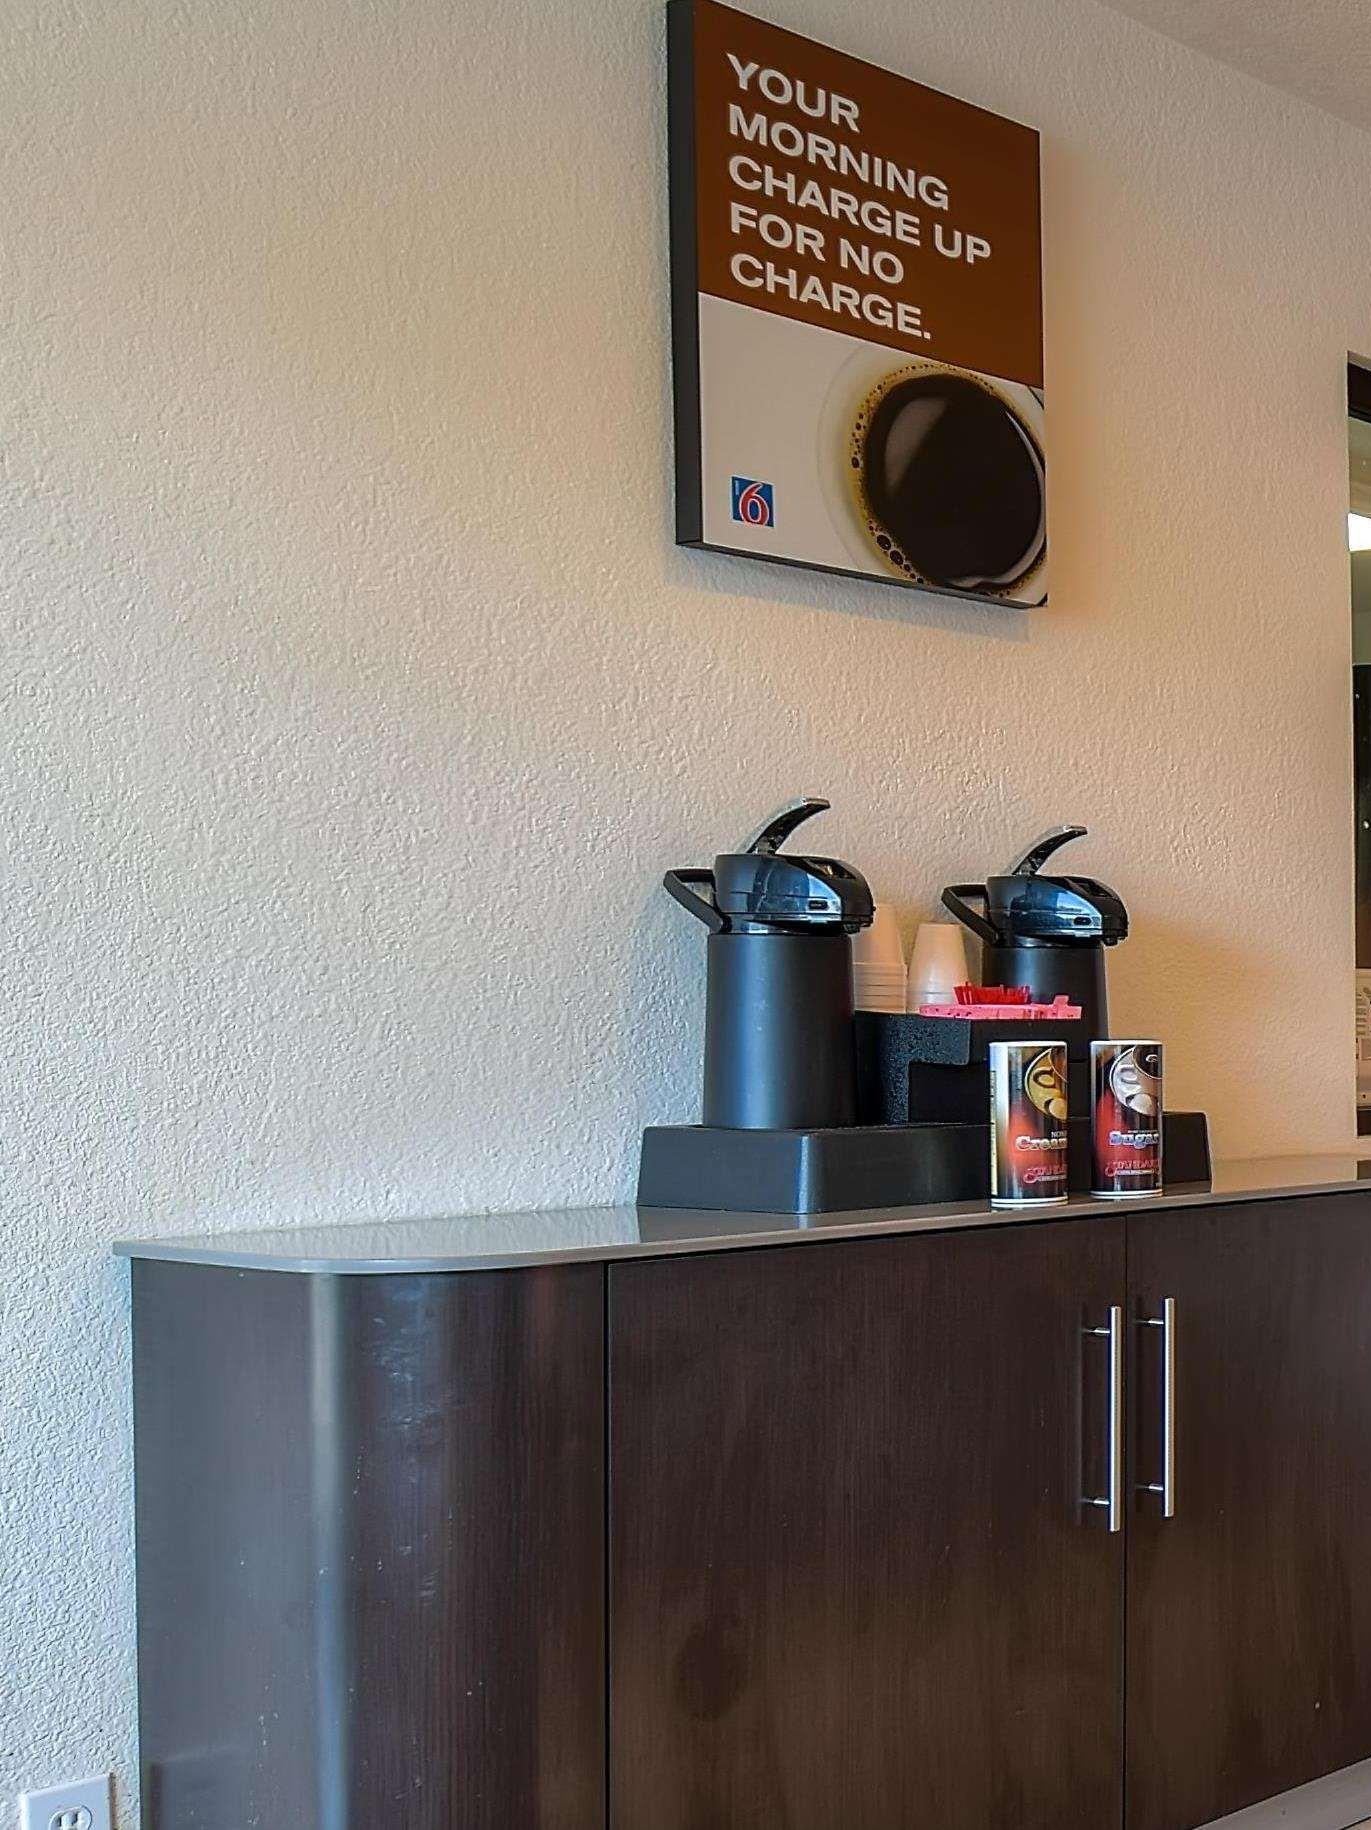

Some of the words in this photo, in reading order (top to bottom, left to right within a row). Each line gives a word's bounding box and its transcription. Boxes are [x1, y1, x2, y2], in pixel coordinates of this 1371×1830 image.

[726, 52, 861, 133] YOUR
[728, 103, 950, 211] MORNING
[728, 155, 922, 248] CHARGE
[933, 225, 993, 265] UP
[730, 202, 826, 262] FOR
[840, 237, 905, 286] NO
[730, 252, 932, 341] CHARGE.
[739, 482, 769, 527] 6
